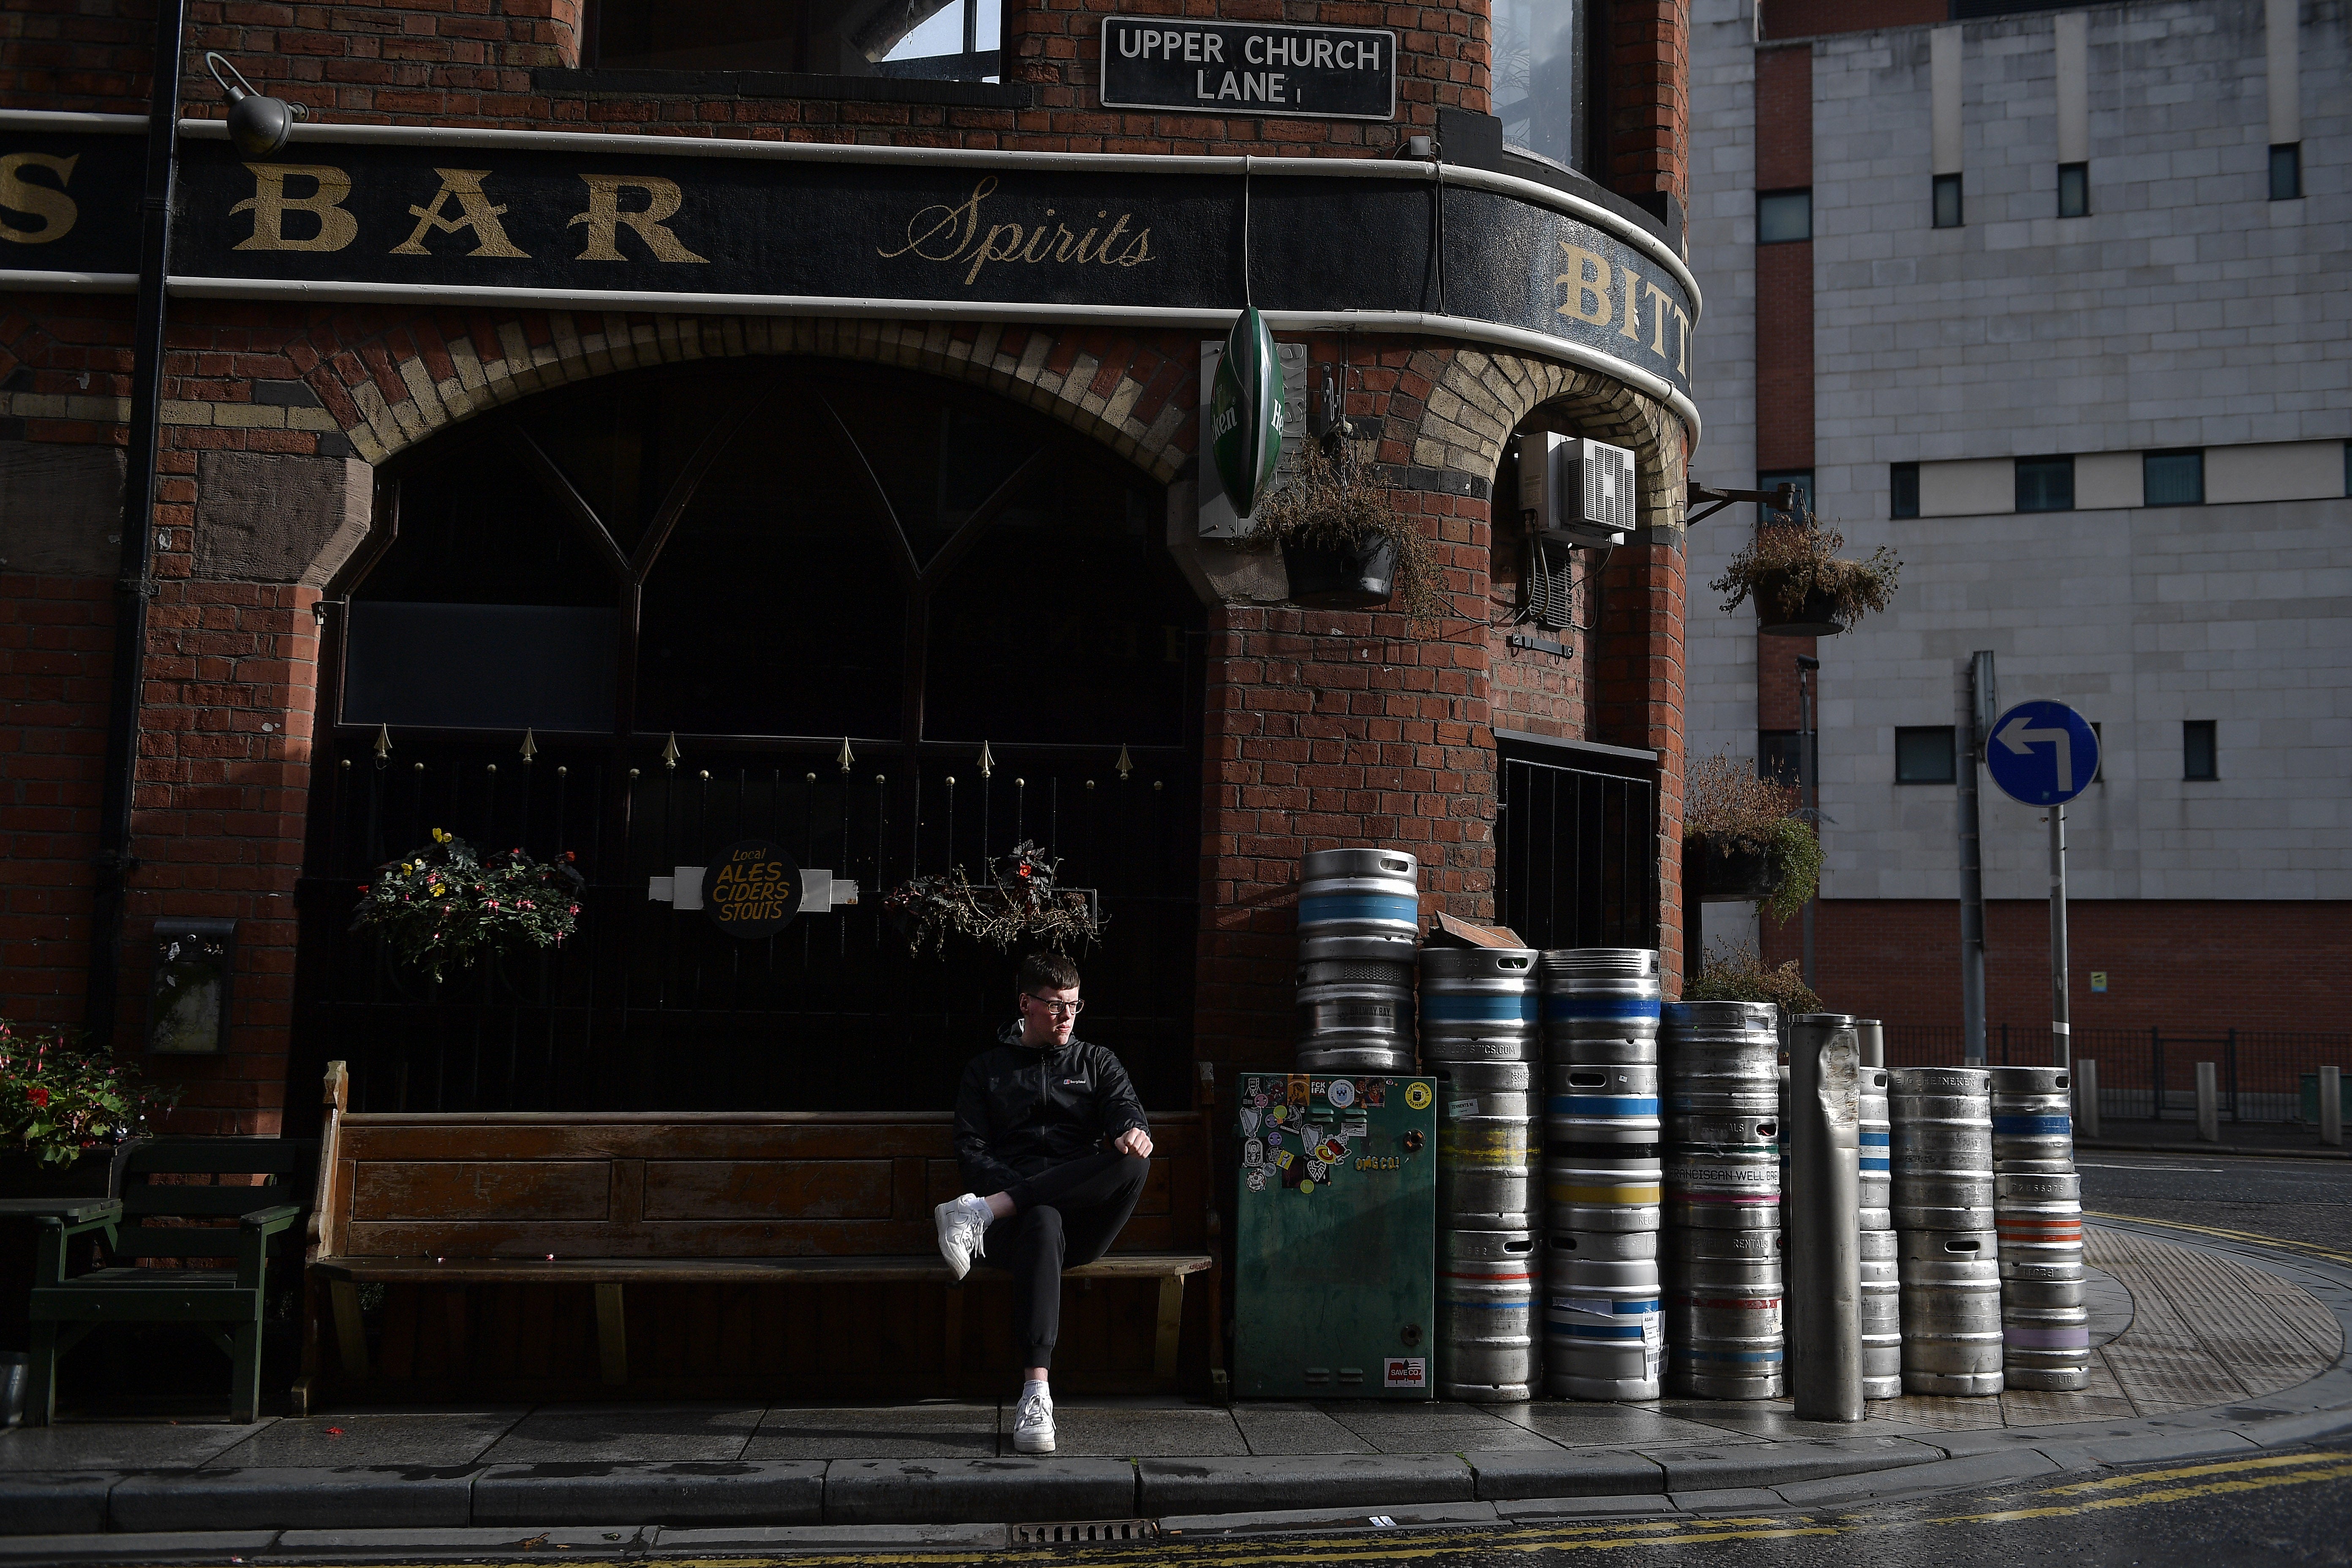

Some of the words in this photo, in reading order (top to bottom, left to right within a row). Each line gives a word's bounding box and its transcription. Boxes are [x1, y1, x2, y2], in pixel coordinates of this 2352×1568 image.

[1119, 29, 1224, 63] UPPER
[1244, 35, 1380, 71] CHURCH
[1197, 70, 1285, 103] LANE
[229, 162, 711, 264] BAR
[877, 176, 1156, 285] Spirits
[732, 848, 765, 861] Local
[717, 862, 782, 884] ALES
[713, 881, 790, 902] CIDERS
[719, 901, 782, 921] STOUTS
[1379, 1007, 1390, 1016] BAY
[1922, 1077, 1975, 1087] HEINEKEN
[1355, 1155, 1379, 1171] OMG
[1669, 1168, 1732, 1181] FRANCISCAN
[1736, 1171, 1764, 1181] WELL
[1639, 1215, 1652, 1225] KEG
[1734, 1239, 1768, 1249] RENTALS
[2058, 1374, 2075, 1384] LTD.
